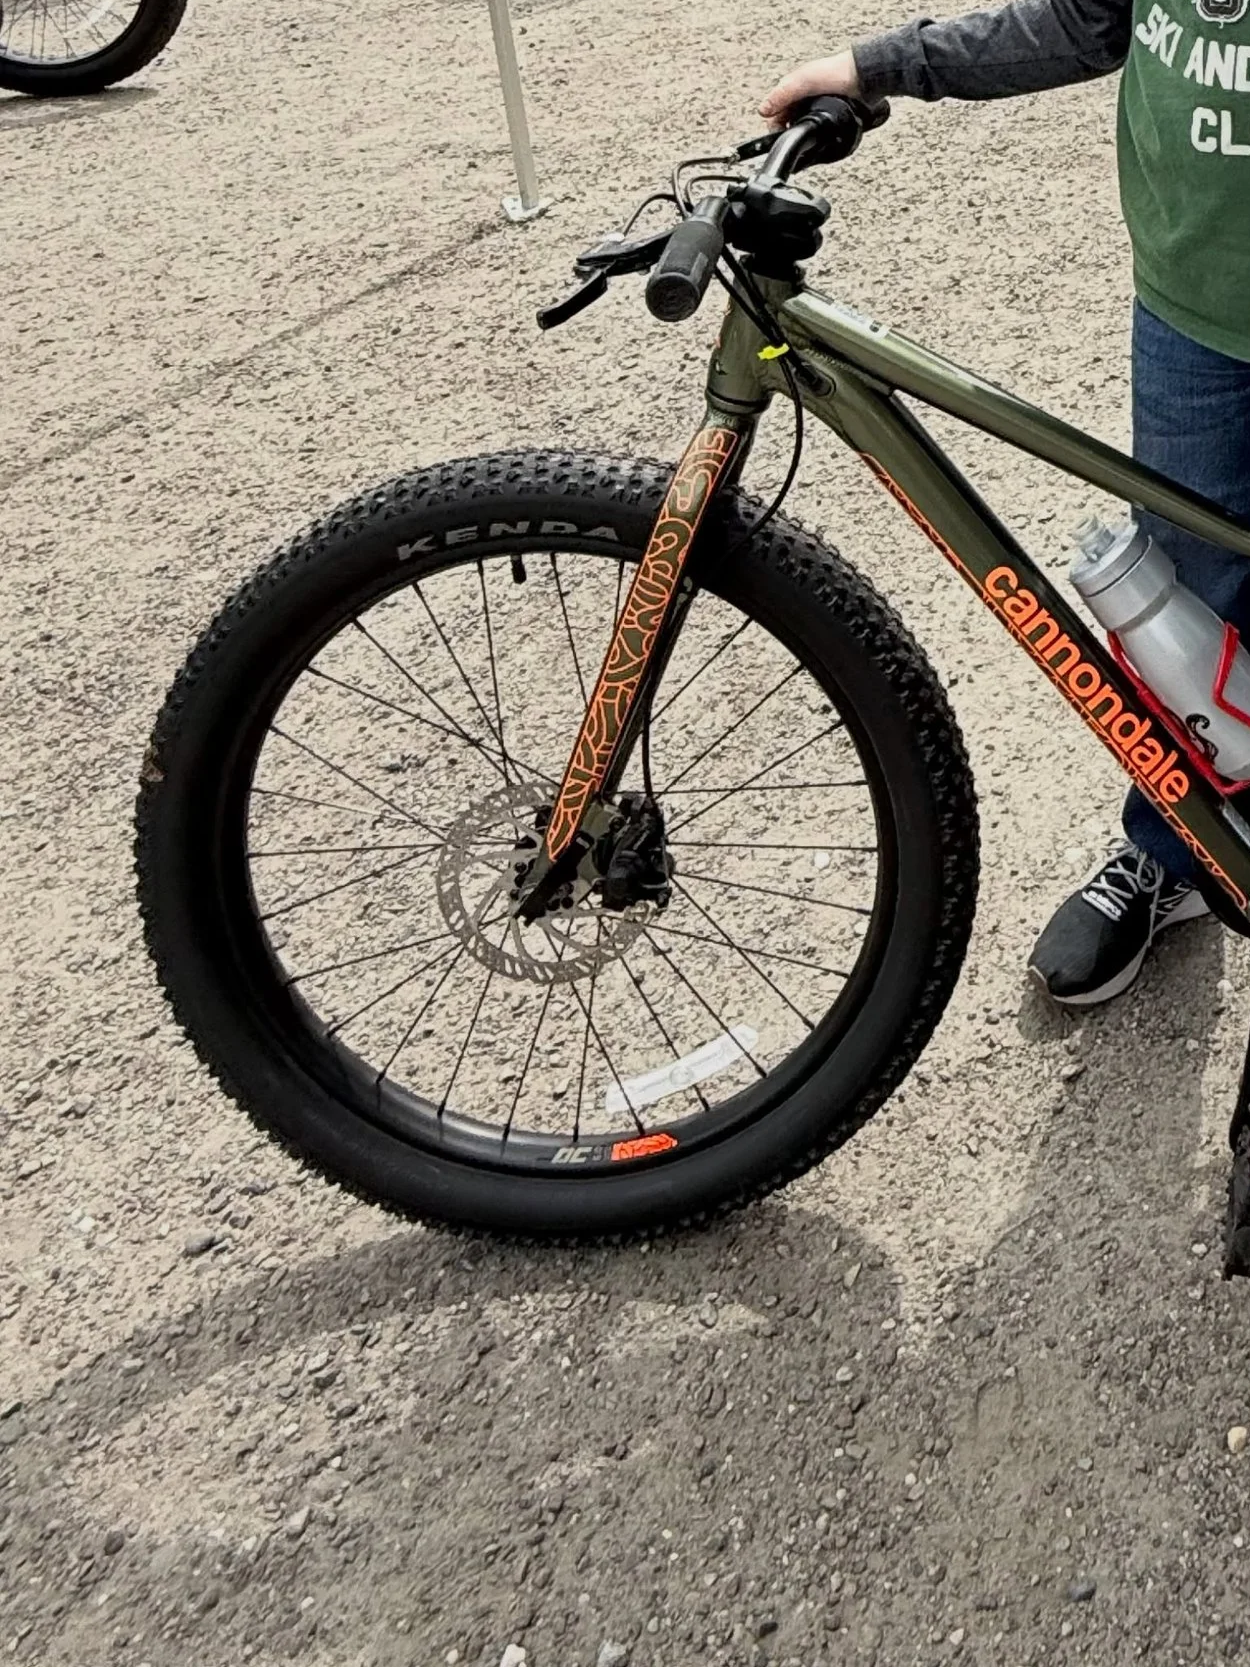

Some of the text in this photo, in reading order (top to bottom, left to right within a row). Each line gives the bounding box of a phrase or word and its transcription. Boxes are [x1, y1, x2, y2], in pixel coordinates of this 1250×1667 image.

[1135, 3, 1183, 68] SKI
[396, 520, 619, 561] KENDA
[985, 566, 1190, 802] cannondale
